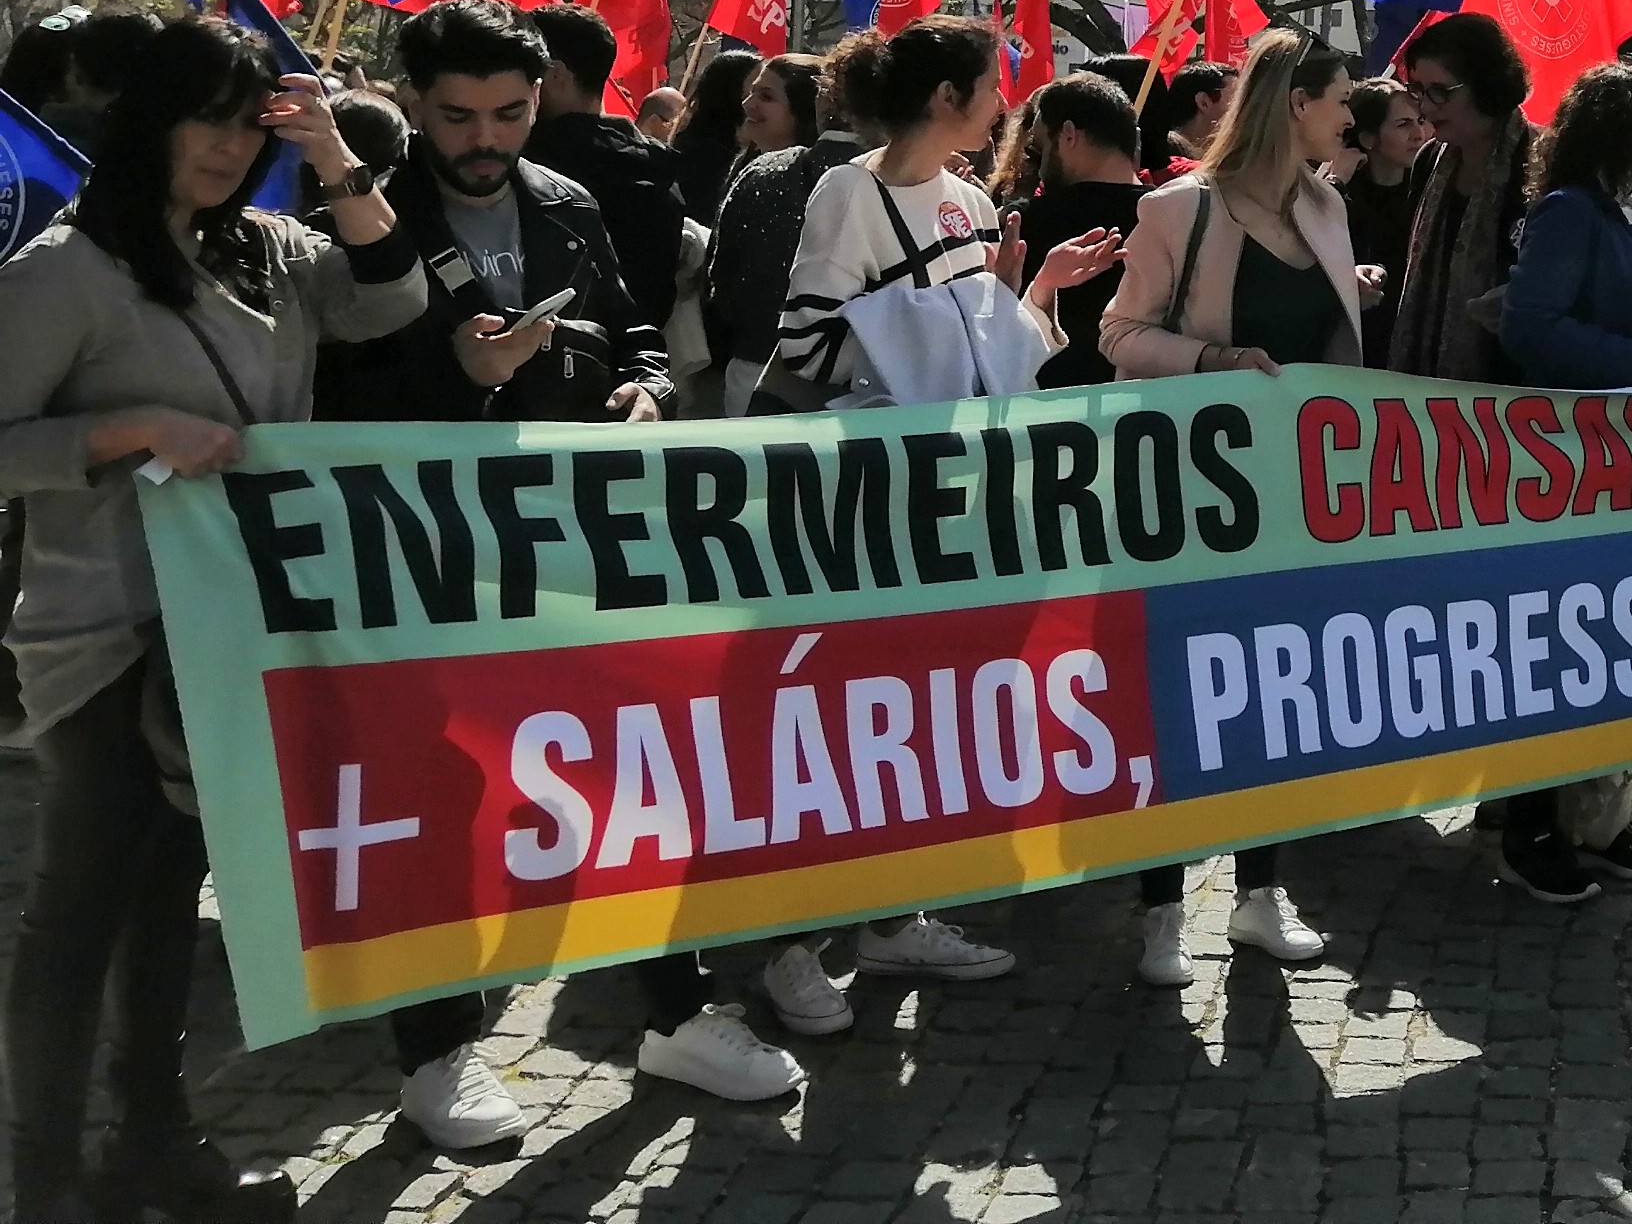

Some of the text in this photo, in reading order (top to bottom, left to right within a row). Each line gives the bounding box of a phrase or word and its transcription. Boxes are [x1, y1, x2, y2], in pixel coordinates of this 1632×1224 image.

[226, 403, 1261, 633] ENFERMEIROS
[298, 763, 420, 912] +
[503, 632, 1155, 883] SALÁRIOS,
